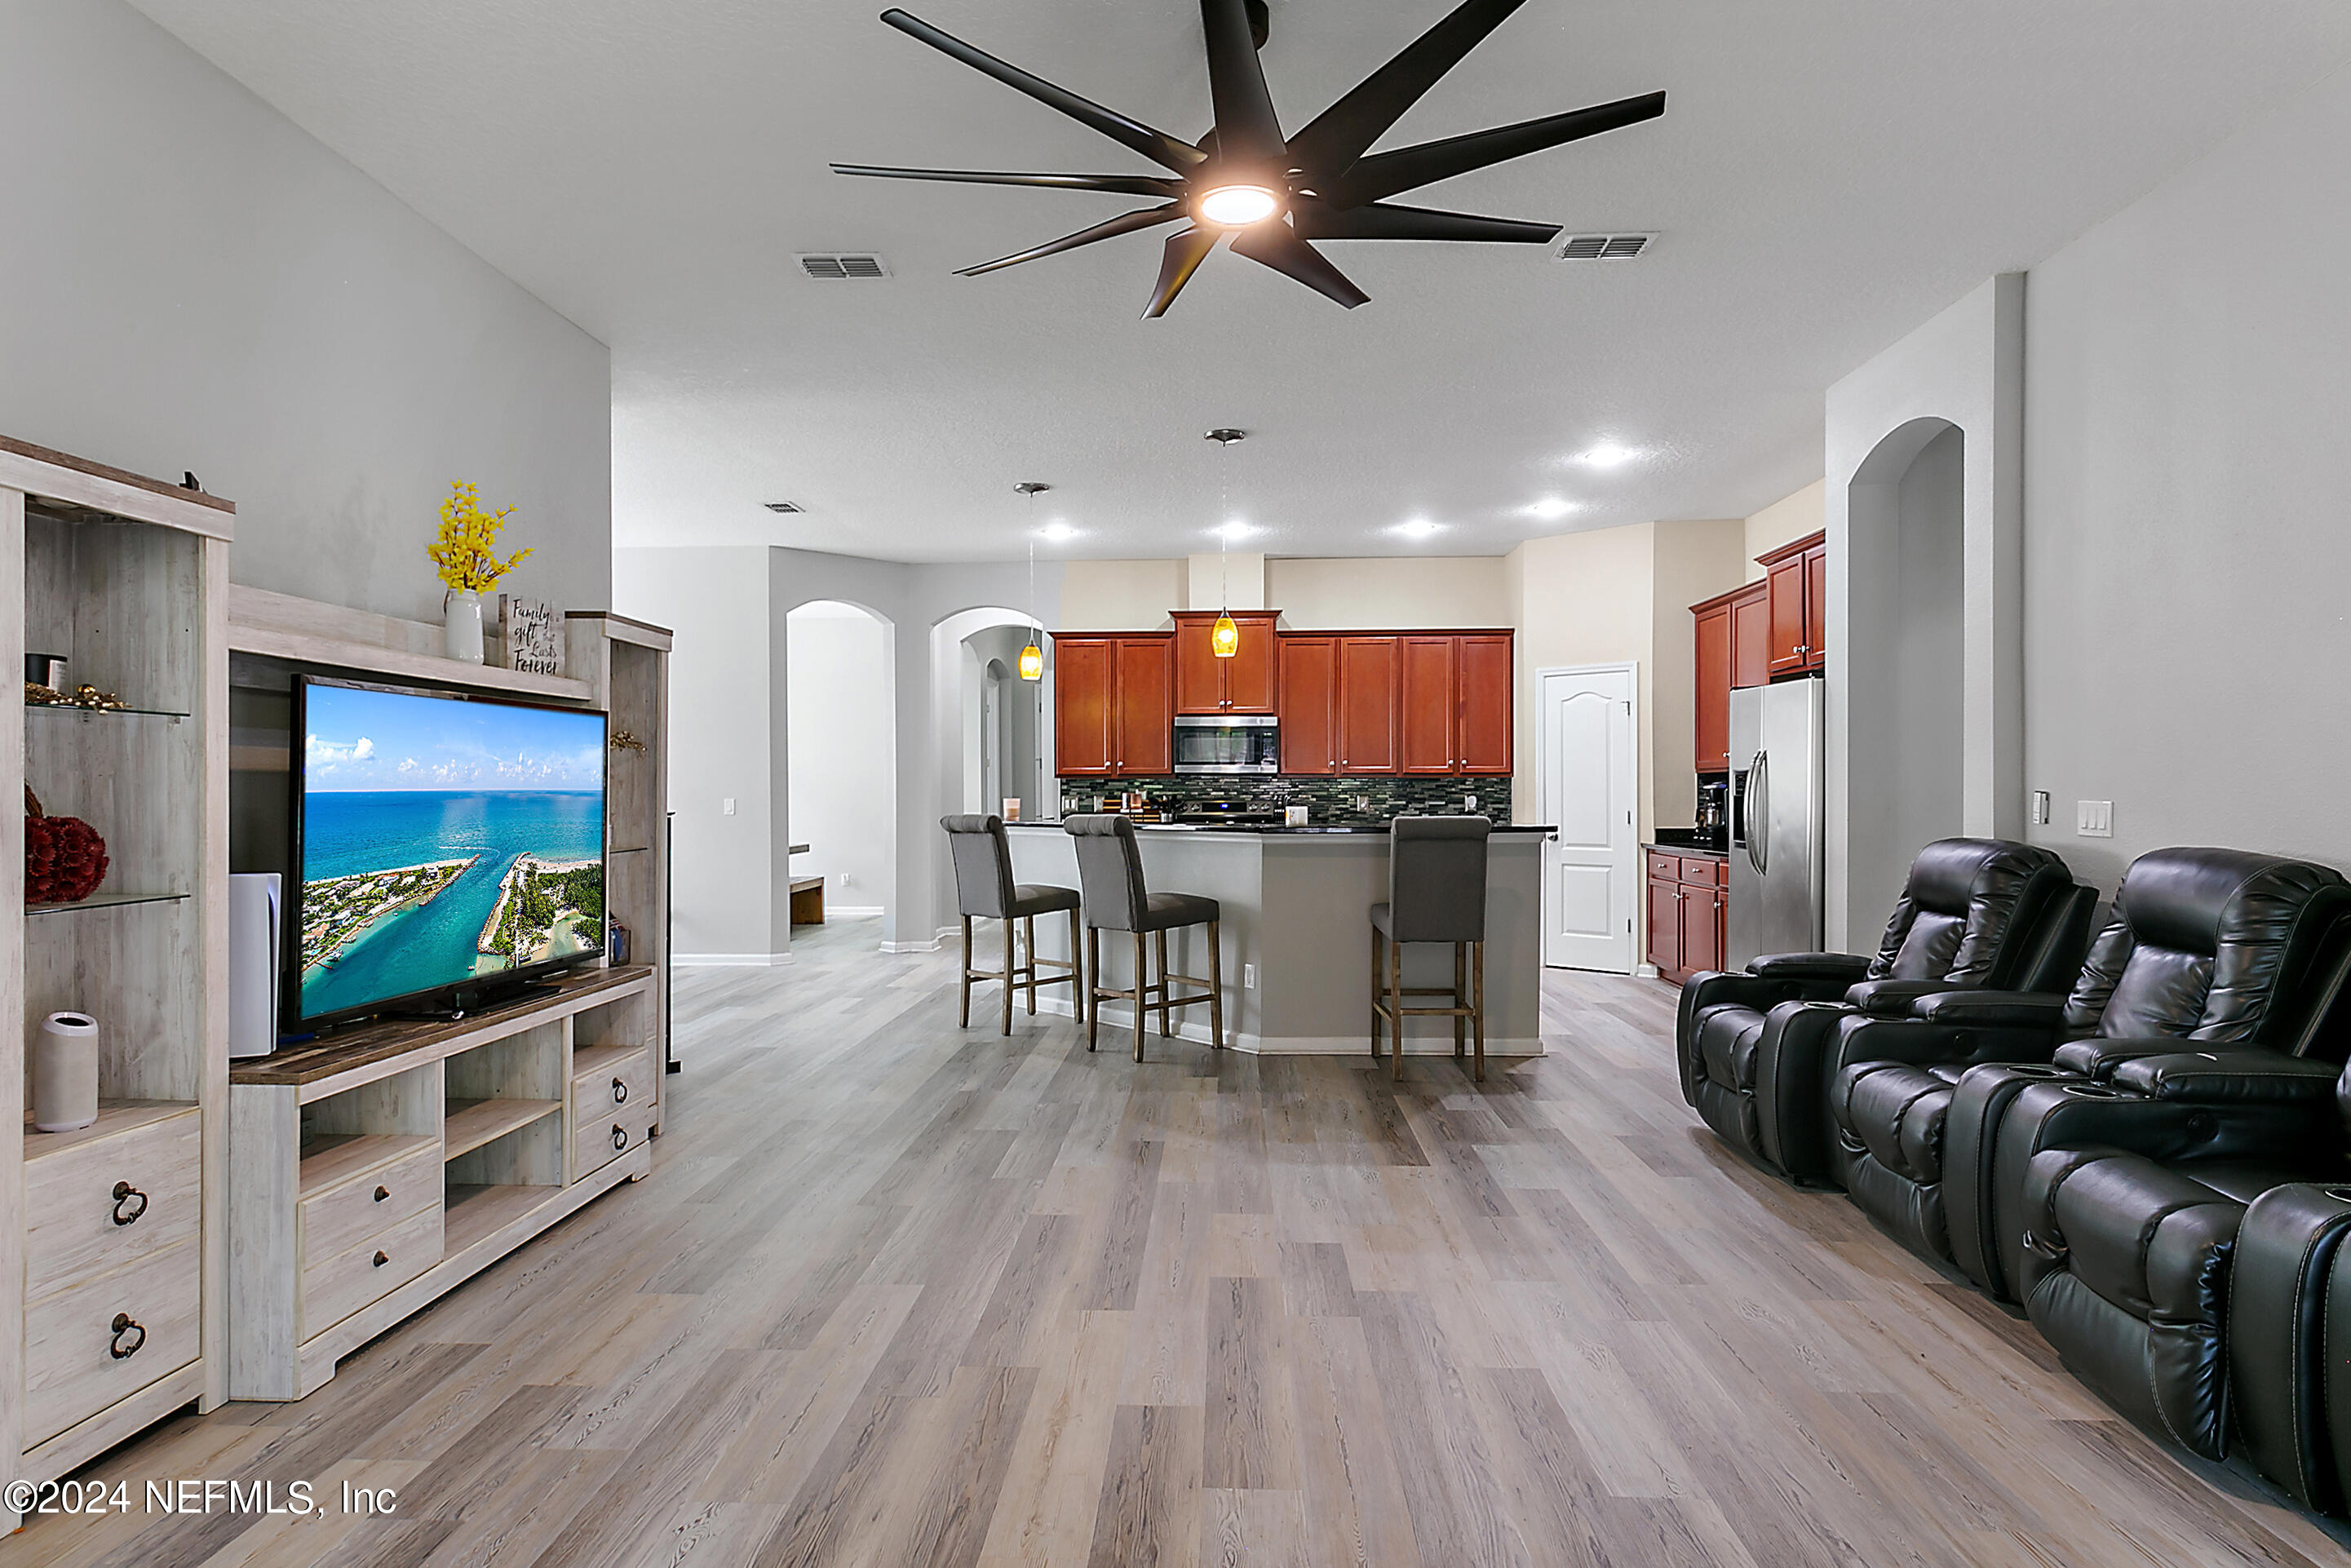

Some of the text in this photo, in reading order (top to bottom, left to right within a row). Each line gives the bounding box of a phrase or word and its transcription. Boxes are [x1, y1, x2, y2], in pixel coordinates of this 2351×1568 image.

[513, 598, 550, 629] Family
[514, 621, 543, 648] gift
[513, 649, 556, 675] Forever
